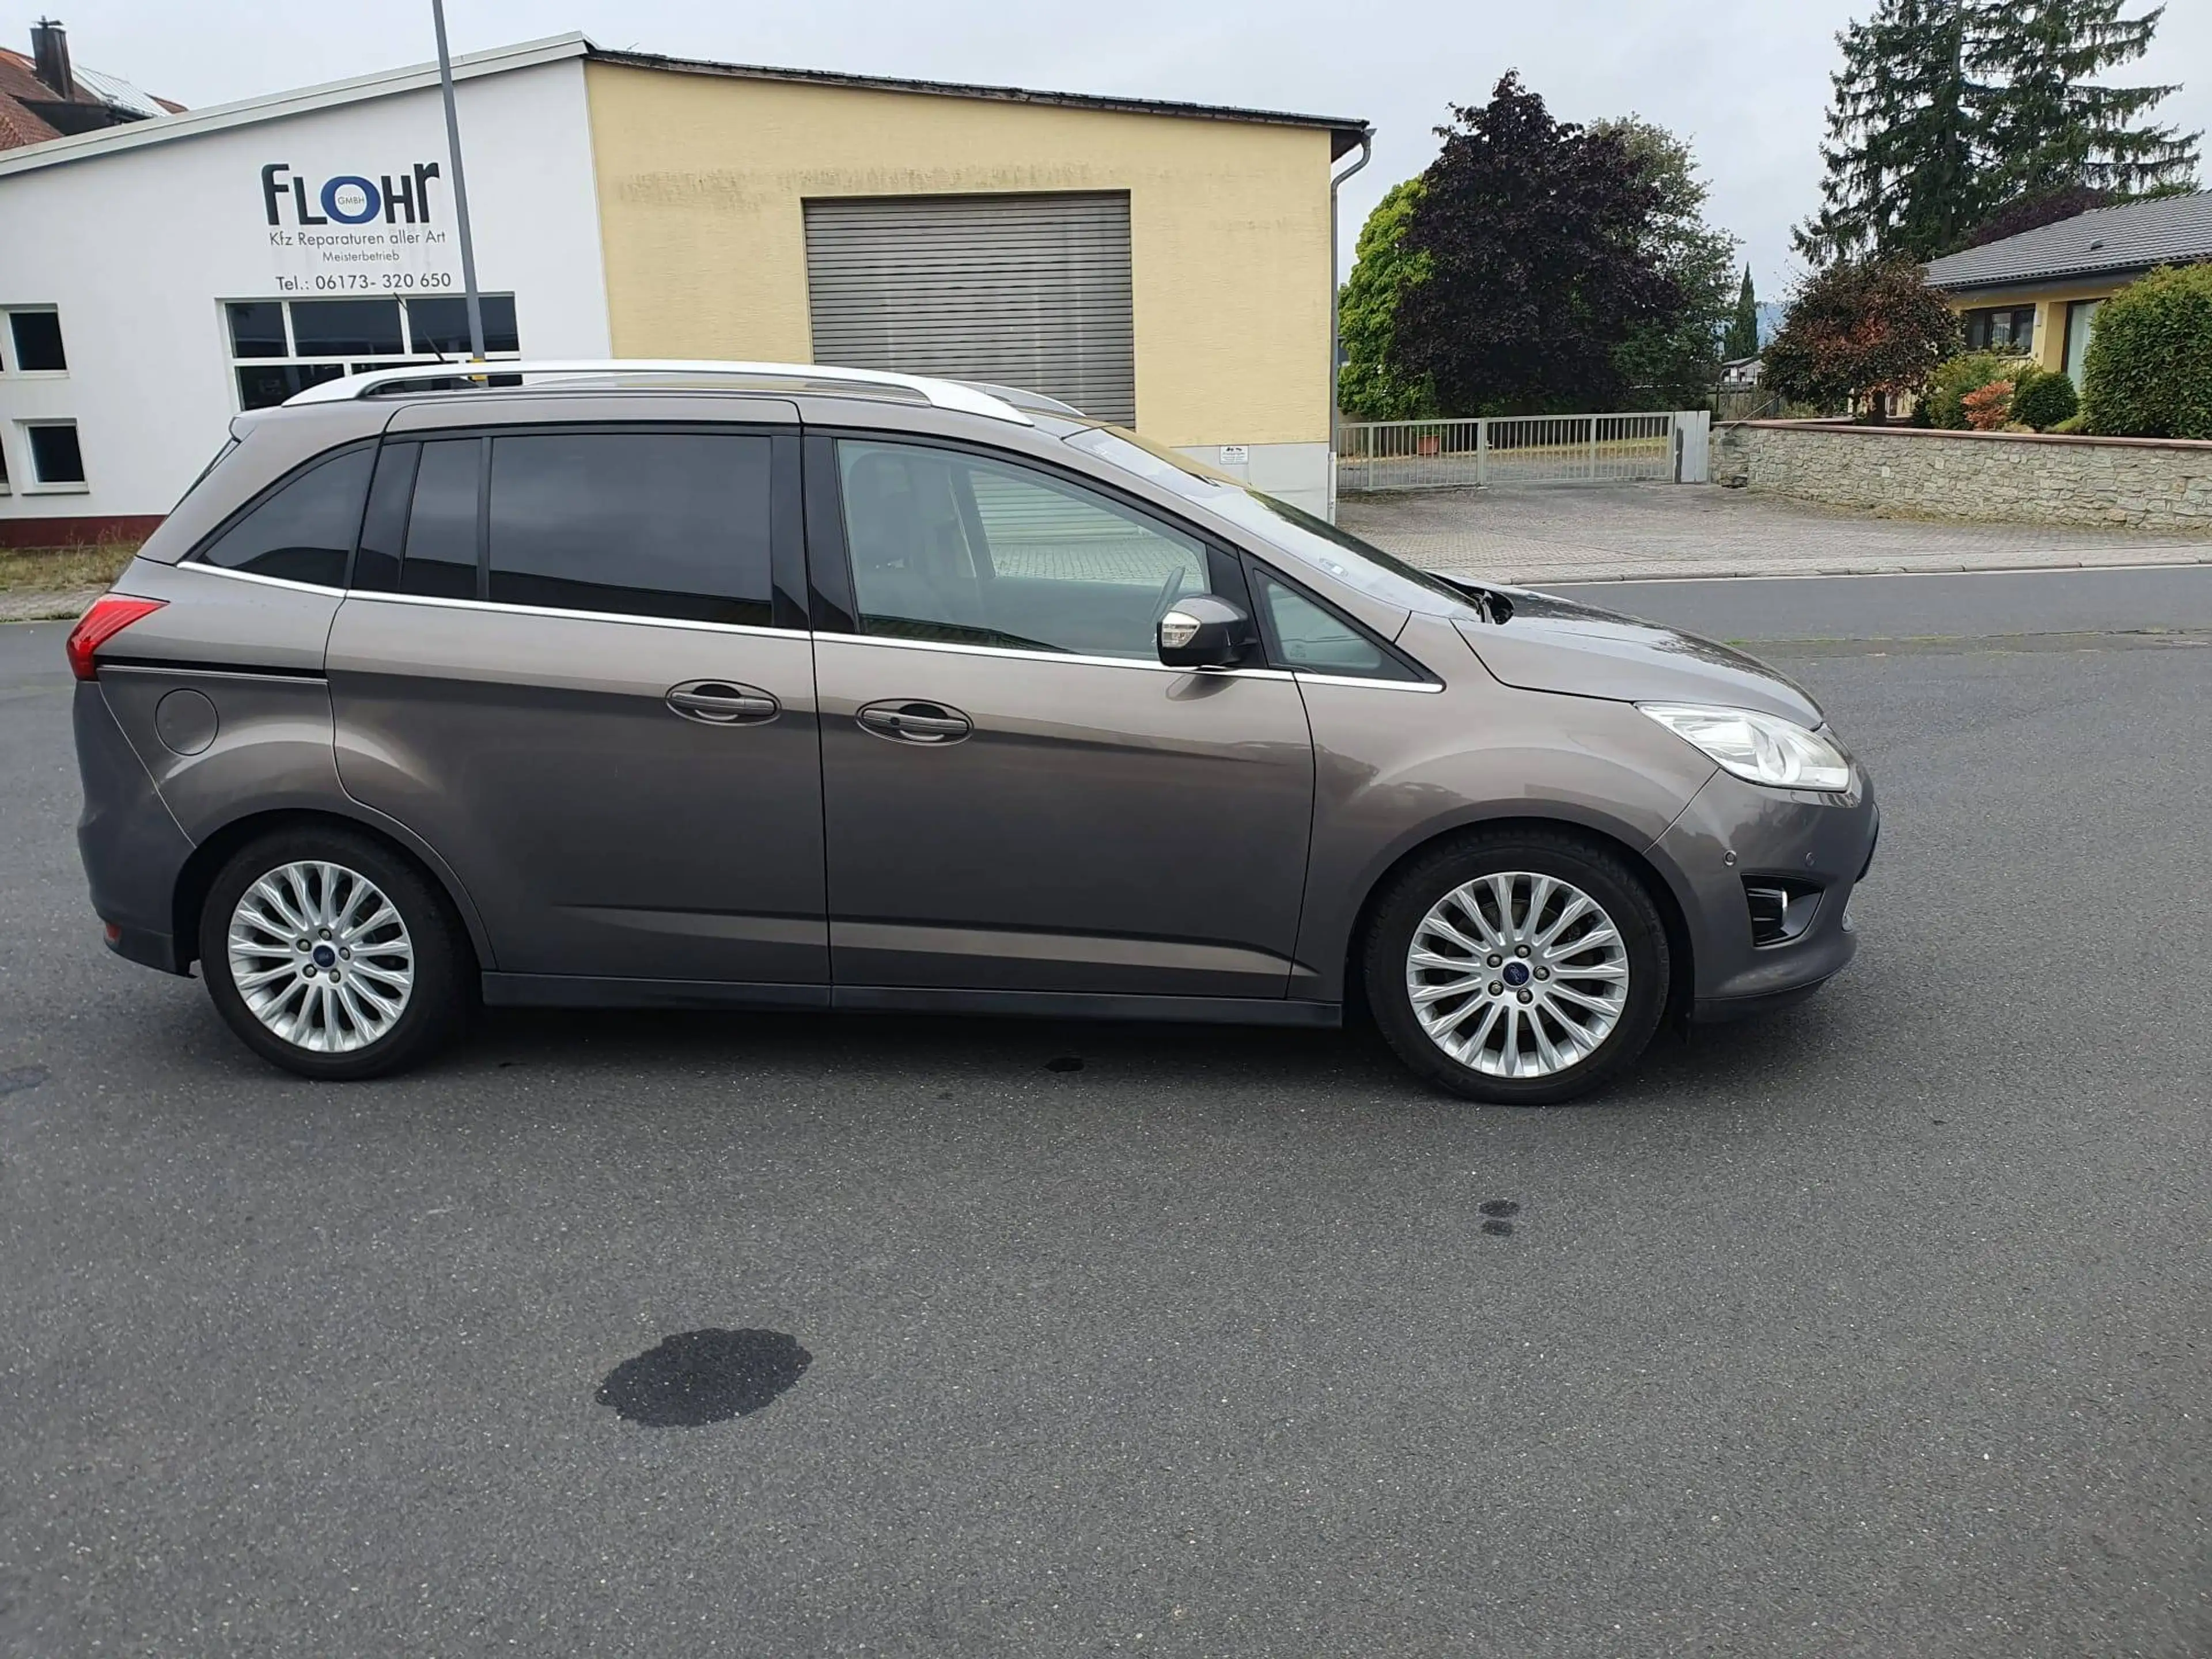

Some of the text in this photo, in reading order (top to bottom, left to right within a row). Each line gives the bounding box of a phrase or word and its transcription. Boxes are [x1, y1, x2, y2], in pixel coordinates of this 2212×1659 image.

[338, 196, 365, 205] GMBH
[270, 229, 446, 249] Kfz Reparaturen aller Art
[322, 249, 400, 263] Meisterbetrieb
[275, 272, 451, 290] Tel.: 06173- 320 650
